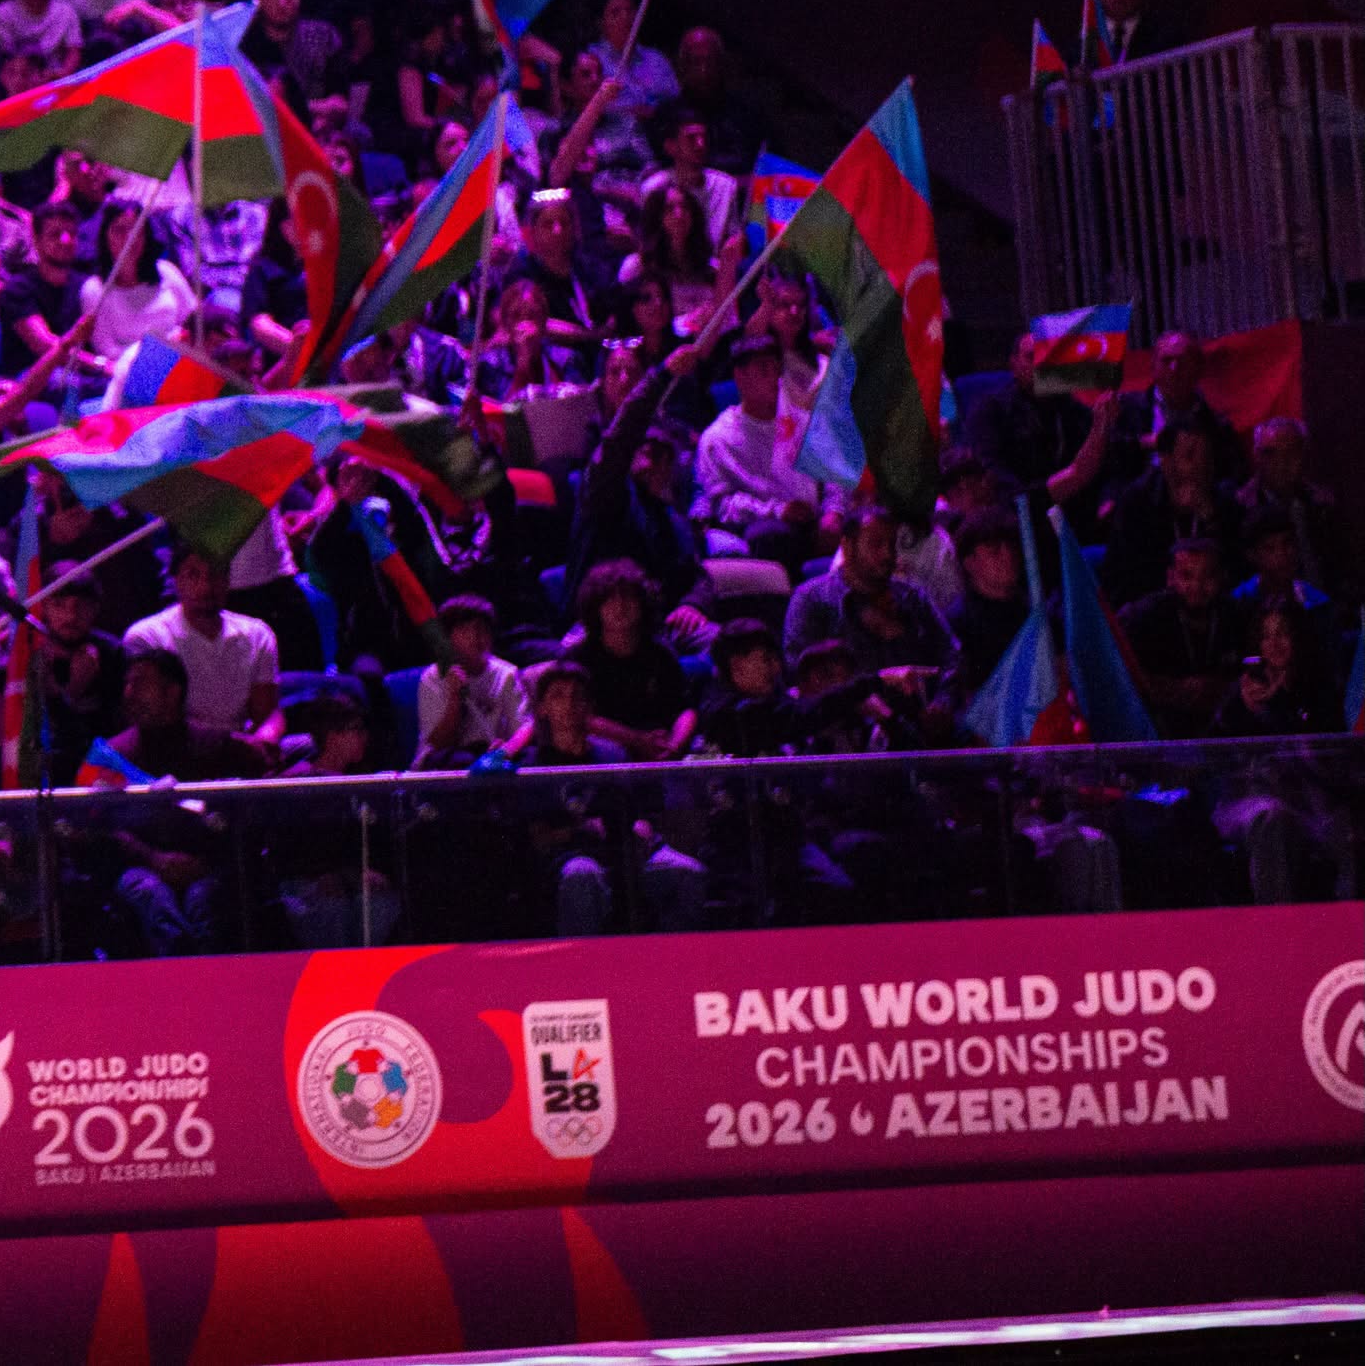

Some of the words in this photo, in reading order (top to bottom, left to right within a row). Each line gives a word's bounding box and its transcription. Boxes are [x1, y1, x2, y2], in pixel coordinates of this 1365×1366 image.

[693, 985, 849, 1037] BAKU
[860, 975, 1059, 1029] WORLD
[1072, 966, 1217, 1017] JUDO
[27, 1056, 127, 1083] WORLD
[134, 1051, 210, 1078] JUDO
[755, 1027, 1169, 1089] CHAMPIONSHIPS
[544, 1081, 601, 1114] 28
[704, 1098, 837, 1149] 2026
[884, 1076, 1230, 1139] AZERBAIJAN
[32, 1101, 215, 1166] 2026
